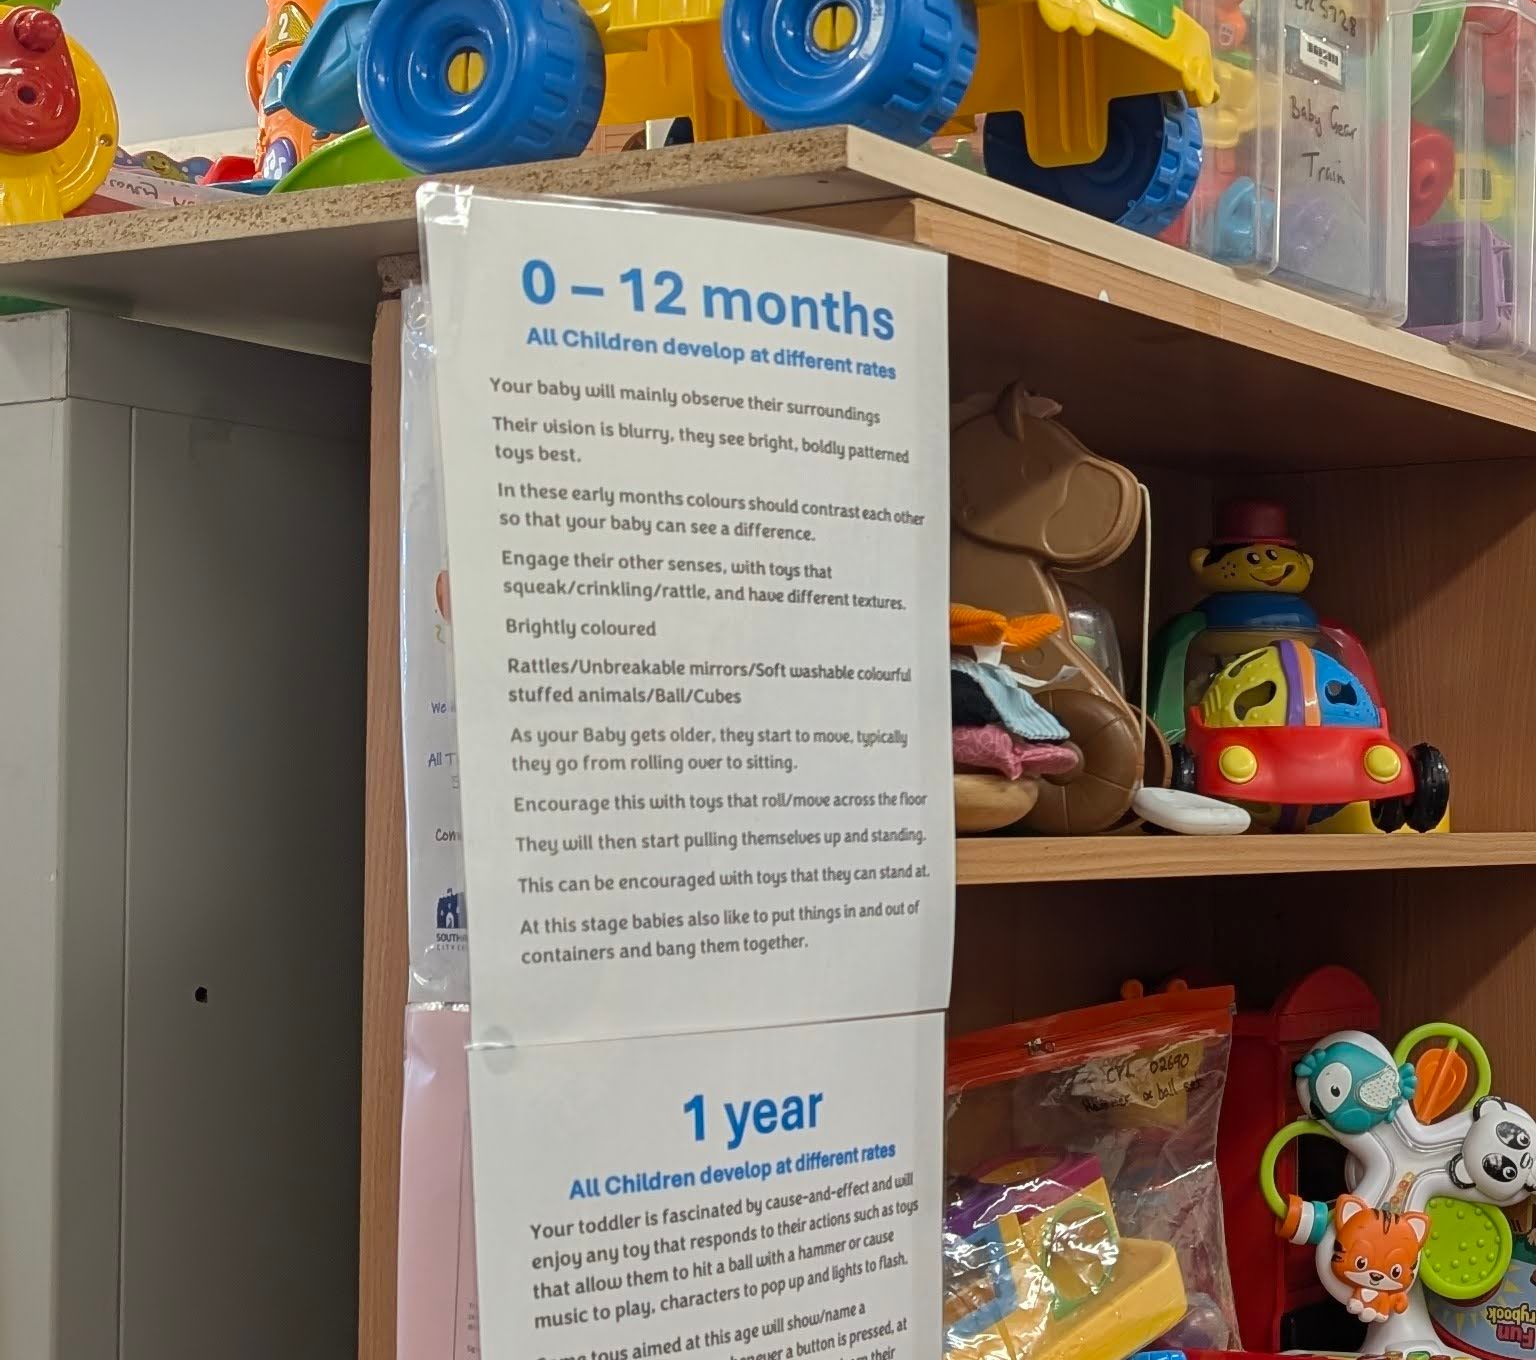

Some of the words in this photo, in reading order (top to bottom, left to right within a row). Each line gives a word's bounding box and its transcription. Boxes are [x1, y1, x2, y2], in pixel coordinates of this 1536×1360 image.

[277, 12, 290, 40] 2
[275, 71, 284, 99] 1
[1289, 94, 1323, 139] Baby
[1301, 150, 1346, 186] Train
[521, 258, 557, 306] 0
[619, 267, 687, 316] 12
[702, 284, 895, 341] months
[526, 326, 559, 347] All
[561, 329, 658, 354] Children
[662, 337, 746, 365] develop
[750, 347, 770, 364] at
[773, 348, 853, 374] different
[855, 361, 897, 381] rates
[489, 376, 534, 395] Your
[536, 379, 582, 402] baby
[584, 382, 616, 400] will
[619, 386, 678, 408] mainly
[680, 389, 745, 410] observe
[747, 395, 784, 413] their
[786, 401, 881, 428] surroundings
[491, 415, 539, 433] Their
[542, 418, 597, 437] vision
[599, 421, 615, 438] is
[618, 422, 675, 446] blurry,
[678, 426, 716, 449] they
[718, 432, 745, 447] see
[747, 431, 799, 454] bright,
[801, 437, 846, 461] boldly
[847, 445, 910, 465] patterned
[497, 481, 516, 498] In
[519, 482, 569, 501] these
[570, 486, 615, 508] early
[618, 489, 684, 507] months
[685, 492, 747, 511] colours
[747, 495, 800, 515] should
[800, 503, 861, 520] contrast
[861, 507, 892, 523] each
[893, 510, 926, 527] other
[503, 578, 711, 603] squeak/crinkling/rattle,
[714, 585, 746, 602] and
[747, 586, 785, 604] have
[786, 588, 850, 607] different
[851, 593, 907, 611] textures.
[505, 617, 577, 640] Brightly
[580, 619, 657, 637] coloured
[507, 657, 686, 676] Rattles/Unbreakable
[688, 660, 787, 678] mirrors/Soft
[788, 663, 855, 681] washable
[856, 666, 912, 683] colourful
[507, 685, 574, 703] stuffed
[577, 686, 742, 705] animals/Ball/Cubes
[683, 1094, 705, 1142] 1
[724, 1092, 823, 1150] year
[569, 1177, 601, 1200] All
[604, 1170, 696, 1196] Children
[699, 1160, 773, 1185] develop
[775, 1157, 793, 1176] at
[795, 1147, 860, 1173] different
[861, 1143, 897, 1163] rates
[529, 1222, 575, 1240] Your
[577, 1213, 642, 1235] toddler
[644, 1210, 659, 1227] is
[661, 1198, 743, 1225] fascinated
[745, 1197, 763, 1217] by
[764, 1180, 870, 1211] cause-and-effect
[870, 1174, 893, 1193] and
[893, 1171, 914, 1189] will
[631, 1335, 683, 1360] aimed
[684, 1334, 701, 1352] at
[703, 1328, 732, 1348] this
[733, 1325, 760, 1345] age
[761, 1316, 785, 1337] will
[786, 1304, 857, 1332] show/name
[858, 1302, 866, 1316] a
[1496, 1322, 1536, 1350] Fun
